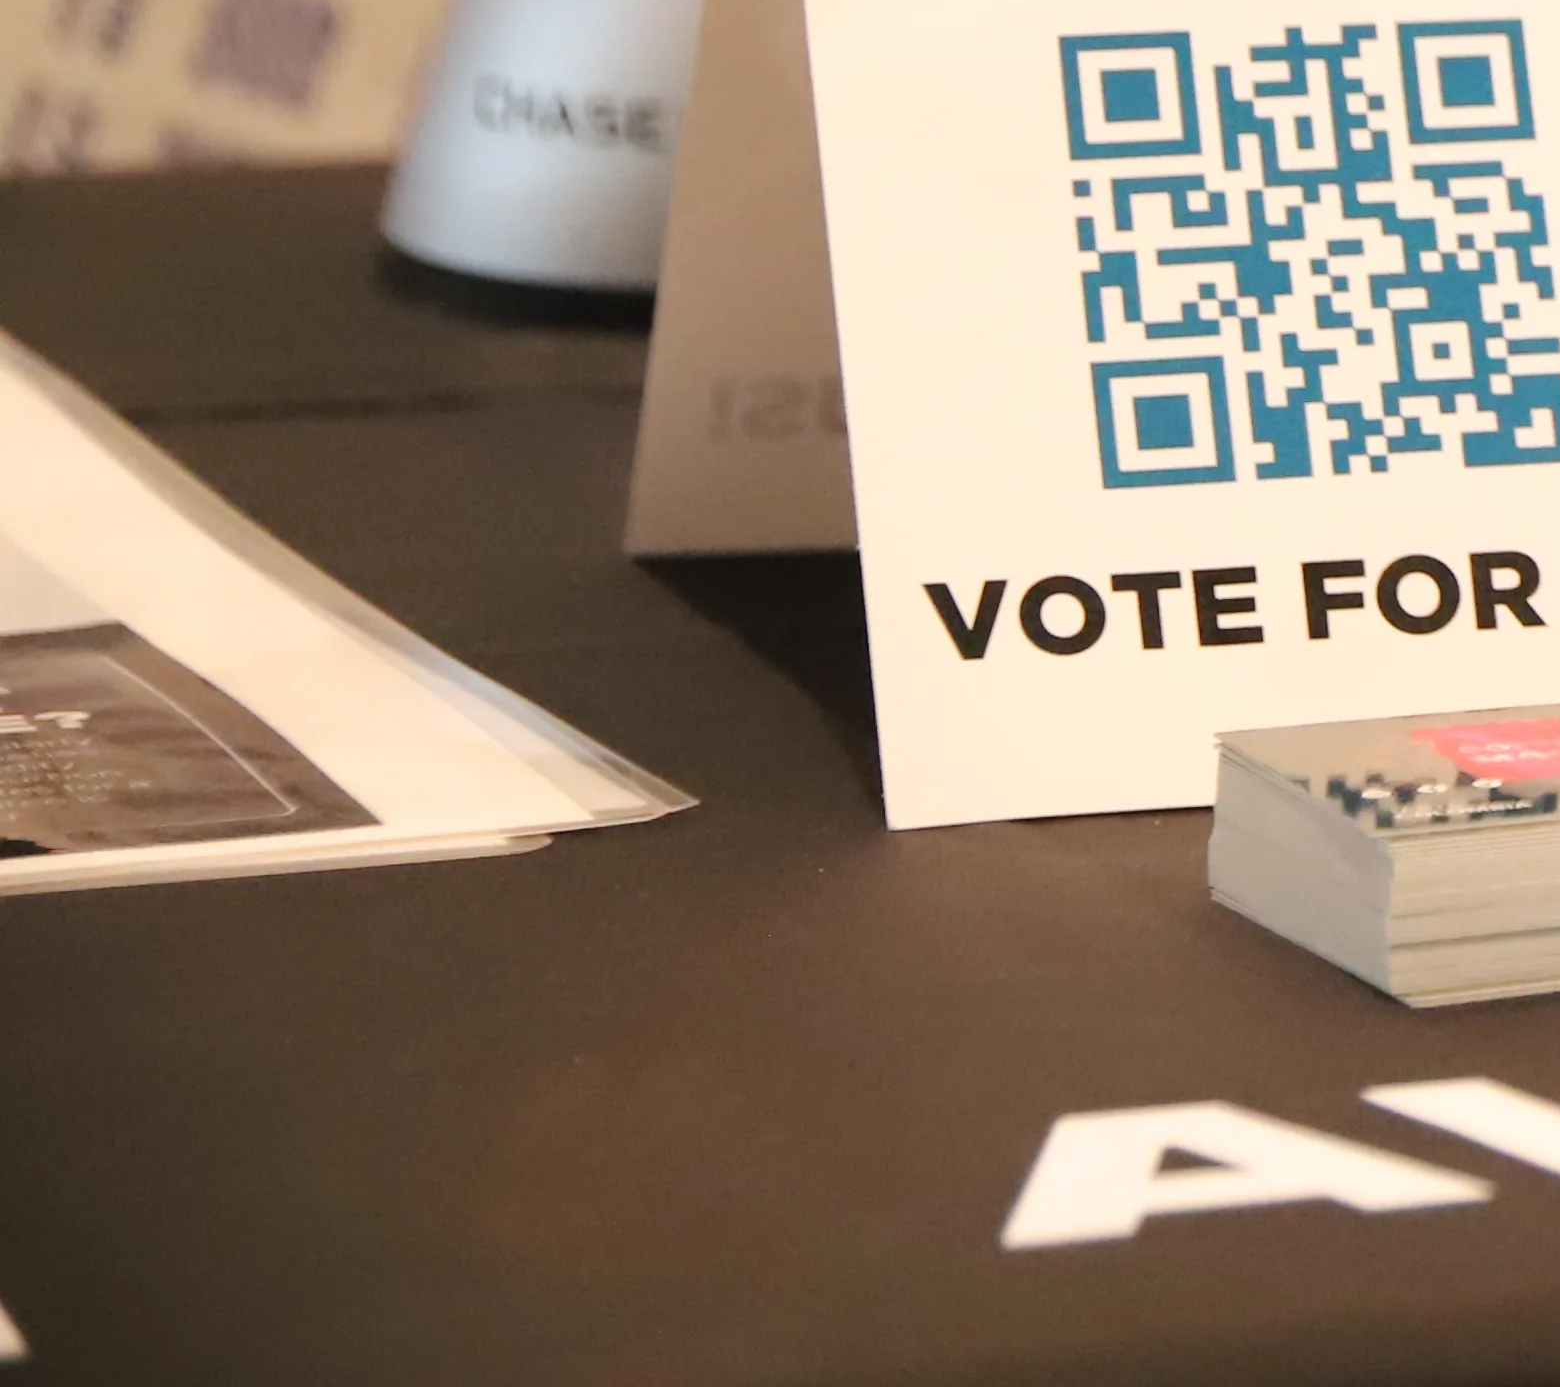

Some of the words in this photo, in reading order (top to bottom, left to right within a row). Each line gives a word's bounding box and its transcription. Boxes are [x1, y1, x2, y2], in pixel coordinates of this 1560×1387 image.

[472, 72, 668, 156] CHASE
[923, 565, 1265, 661] VOTE
[1300, 549, 1548, 641] FOR
